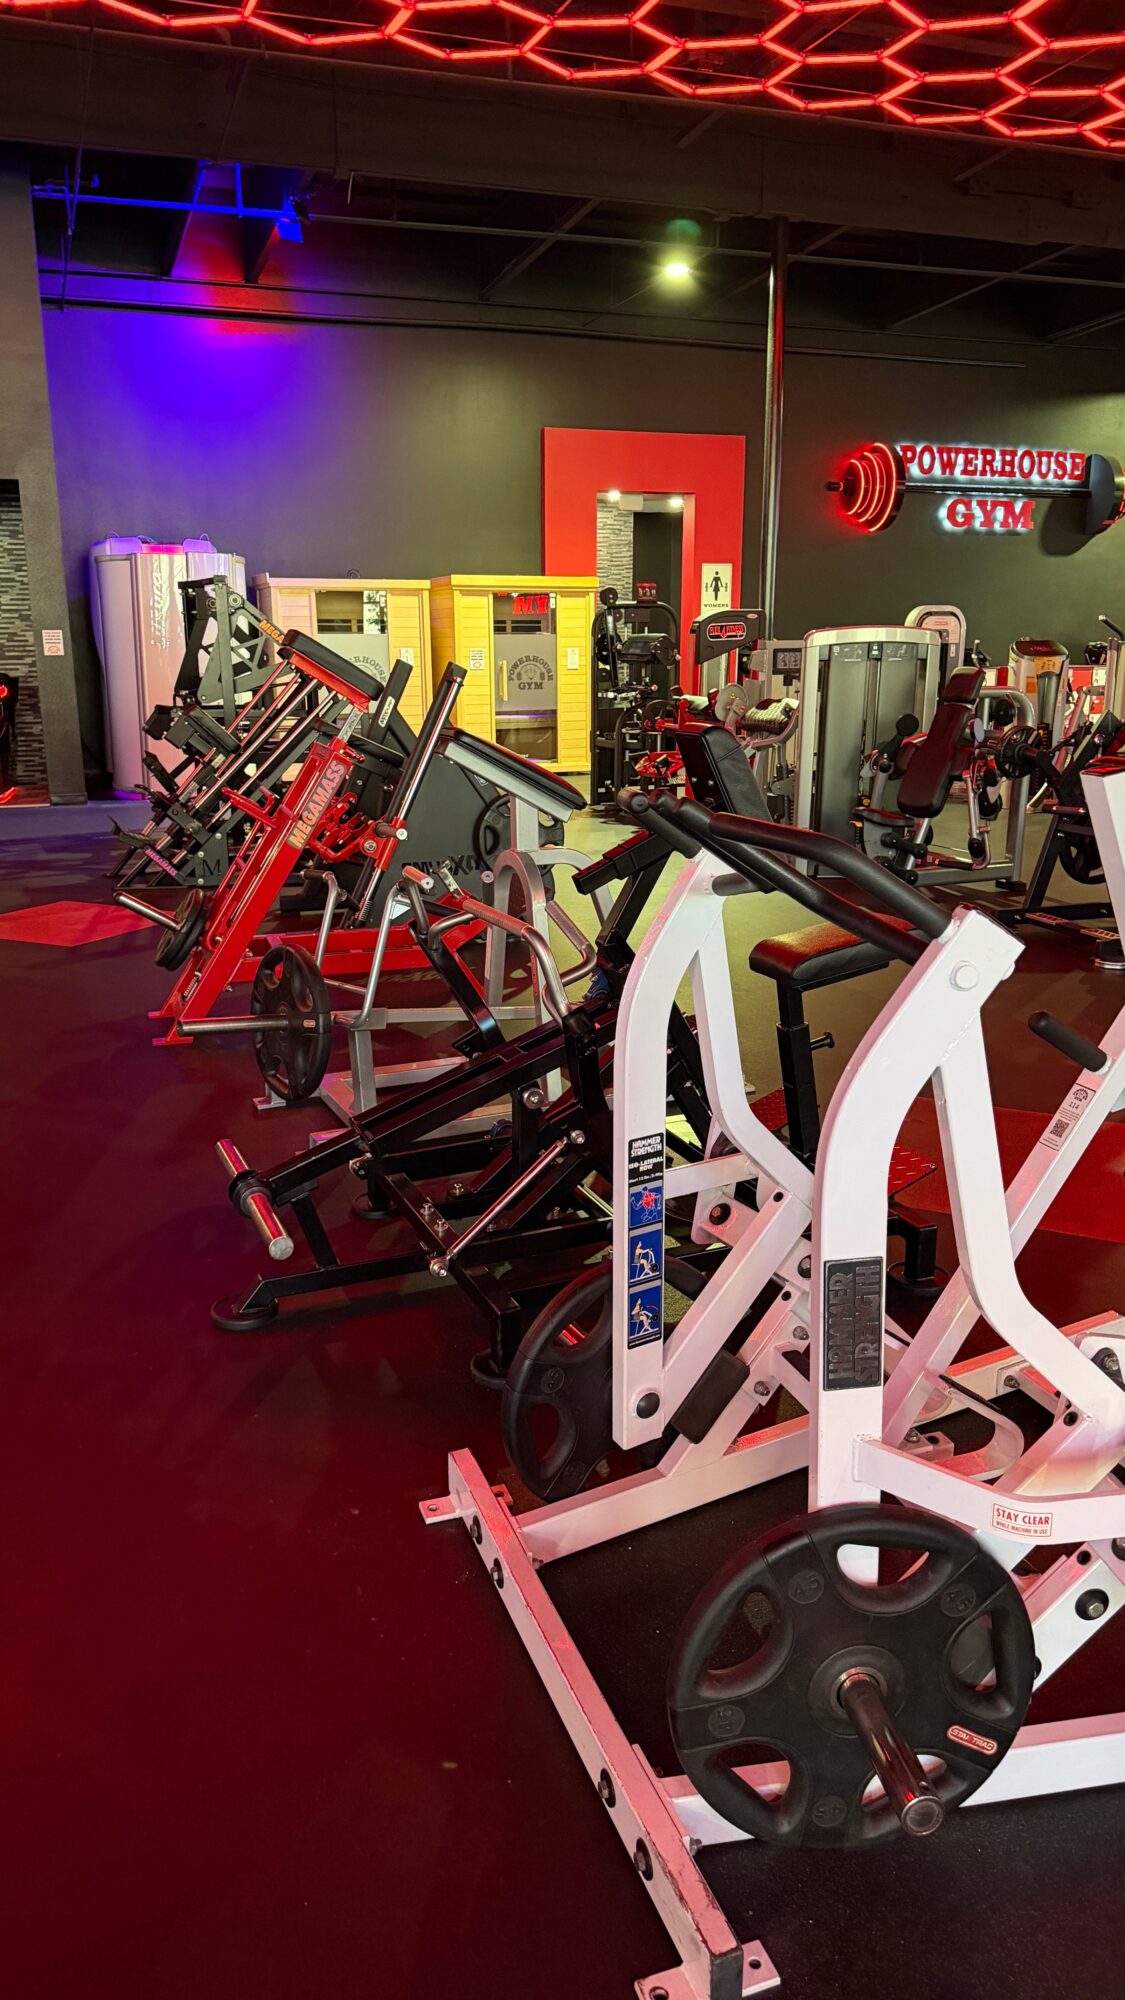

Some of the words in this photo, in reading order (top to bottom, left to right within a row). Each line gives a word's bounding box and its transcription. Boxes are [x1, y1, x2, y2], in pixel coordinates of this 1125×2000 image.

[899, 444, 1086, 481] POWERHOUSE
[946, 498, 1036, 529] GYM
[508, 655, 554, 682] POWERHOUSE
[518, 681, 544, 691] GYM
[288, 760, 346, 848] MEGAMASS
[630, 1143, 662, 1158] STRENGTH
[632, 1136, 661, 1149] HAMMER
[828, 1272, 854, 1381] HAMMER
[854, 1265, 881, 1383] STRENGTH
[995, 1521, 1009, 1530] WHILE
[1011, 1525, 1032, 1534] MACHINE
[996, 1507, 1019, 1522] STAY
[1022, 1515, 1050, 1526] CLEAR
[972, 1737, 994, 1750] TRAC
